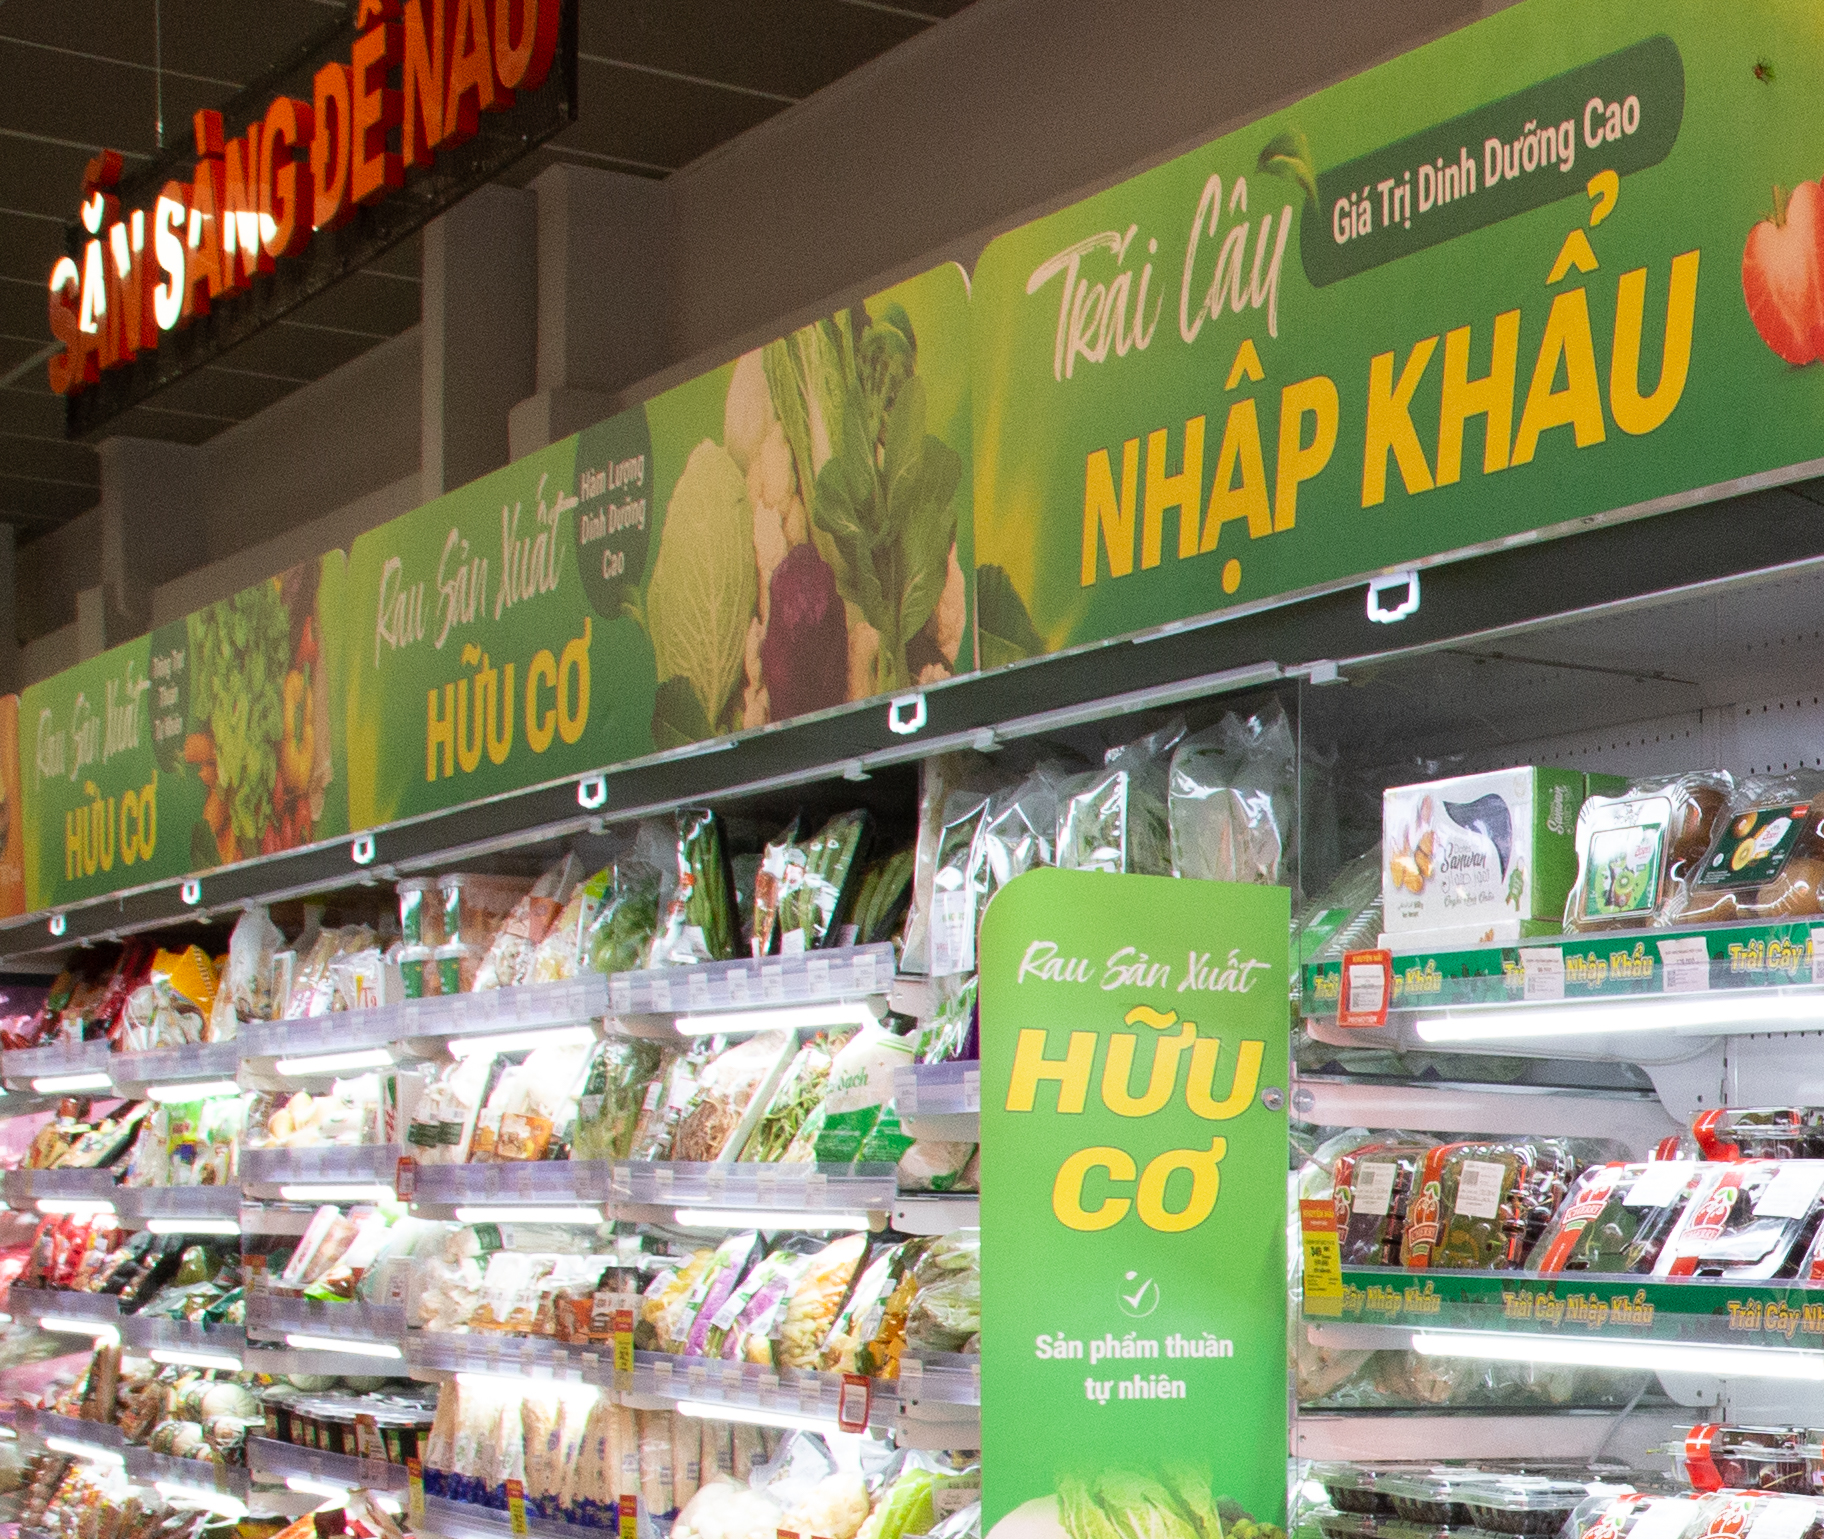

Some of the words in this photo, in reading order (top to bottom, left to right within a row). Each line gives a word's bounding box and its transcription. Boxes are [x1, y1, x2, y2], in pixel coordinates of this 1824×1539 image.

[1332, 188, 1374, 246] Giá
[1377, 174, 1413, 232] Trị
[1417, 145, 1477, 214] Dinh
[1484, 111, 1576, 181] Dưỡng
[1582, 92, 1642, 150] Cao
[1025, 222, 1167, 383] Trái
[1177, 173, 1292, 340] Cây
[1079, 338, 1341, 598] NHẬP
[1360, 167, 1703, 509] KHẨU
[580, 511, 605, 546] Dinh
[602, 548, 624, 581] Cao
[425, 642, 518, 783] HỮU
[525, 616, 593, 754] CƠ
[1016, 937, 1098, 990] Rau
[1101, 941, 1175, 995] Sản
[1176, 937, 1271, 994] Xuất
[1003, 1003, 1267, 1121] HỮU
[1050, 1134, 1228, 1235] CƠ
[1033, 1331, 1081, 1362] Sản
[1088, 1327, 1162, 1372] phẩm
[1164, 1328, 1235, 1362] thuần
[1084, 1371, 1115, 1407] tự
[1118, 1371, 1187, 1402] nhiên
